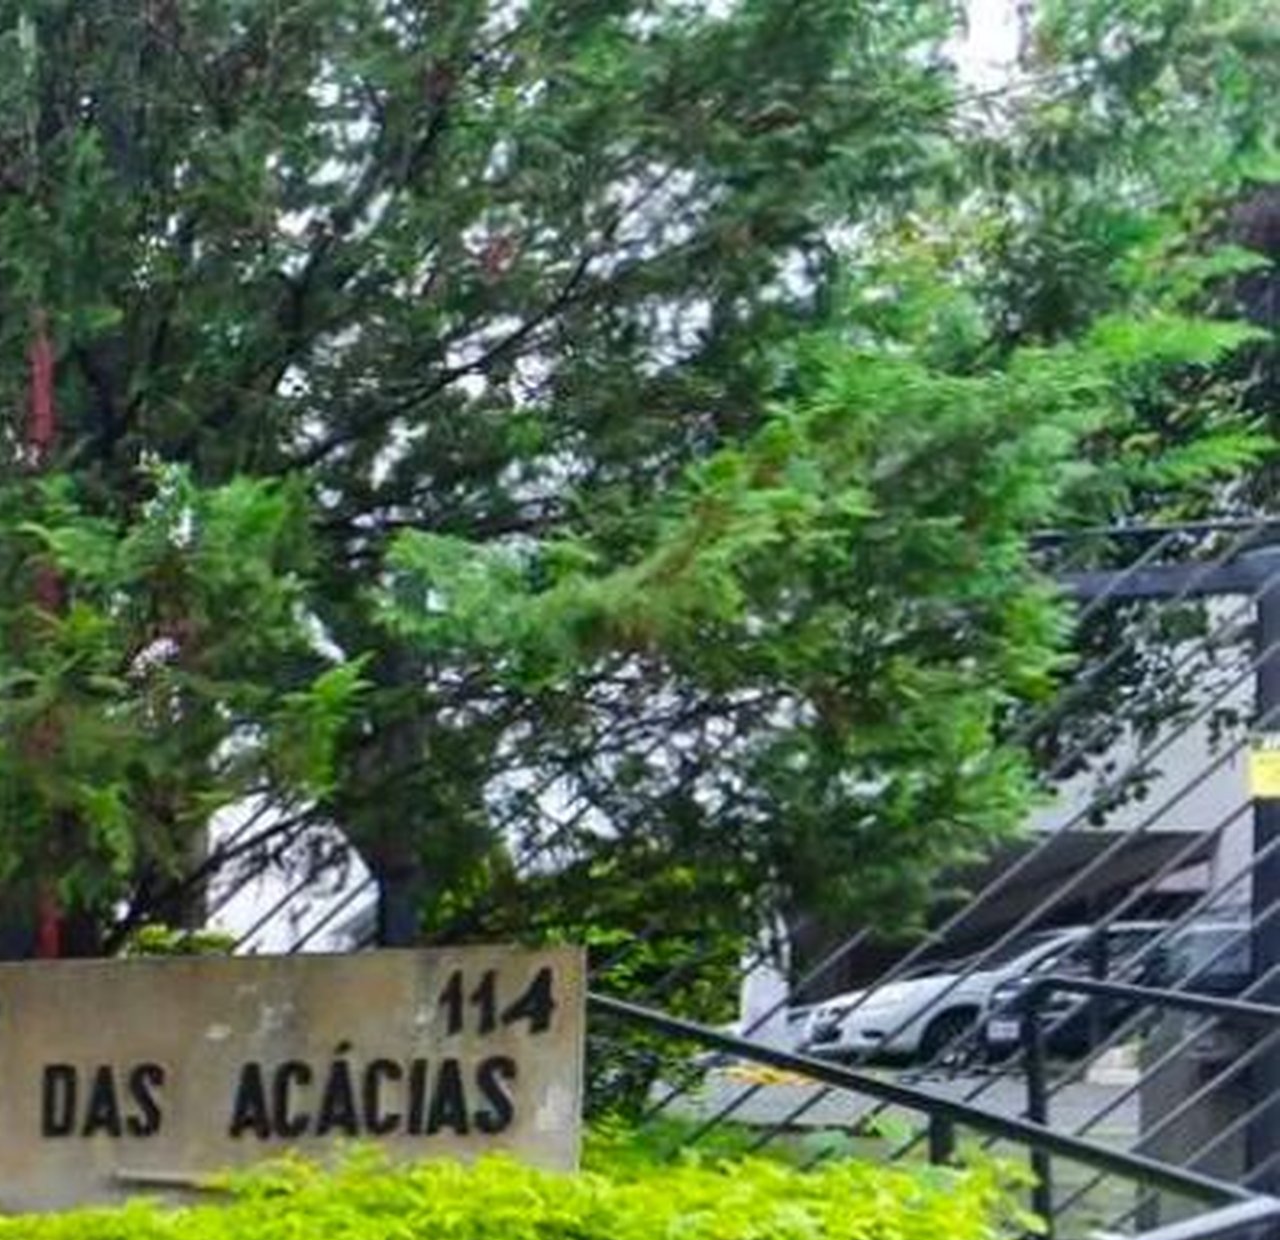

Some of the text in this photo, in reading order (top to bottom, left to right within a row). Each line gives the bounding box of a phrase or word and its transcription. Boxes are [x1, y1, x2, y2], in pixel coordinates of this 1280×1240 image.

[439, 966, 555, 1036] 114
[42, 1063, 165, 1138] DAS
[229, 1041, 518, 1140] ACÁCIAS
